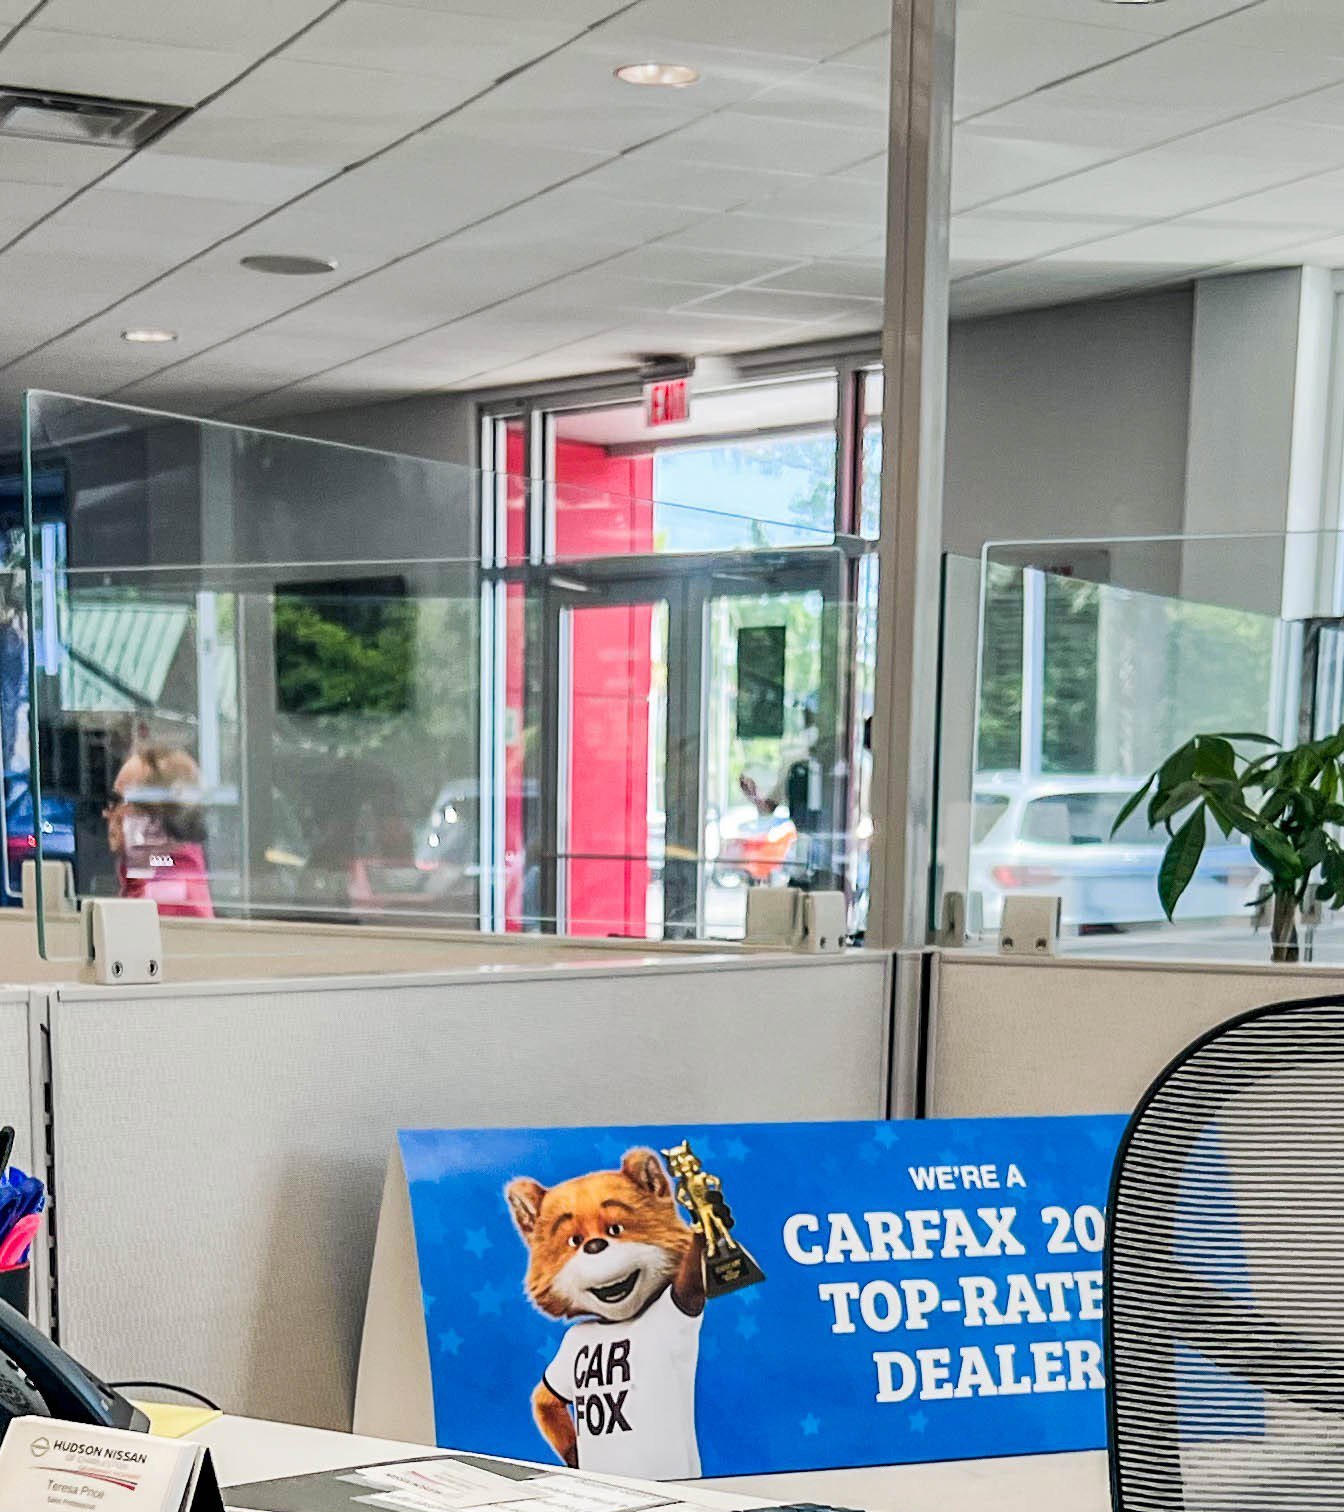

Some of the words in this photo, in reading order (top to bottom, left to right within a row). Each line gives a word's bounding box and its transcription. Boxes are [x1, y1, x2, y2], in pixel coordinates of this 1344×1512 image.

[908, 1165, 1001, 1191] WE'RE
[1006, 1163, 1027, 1188] A
[783, 1206, 1026, 1265] CARFAX
[818, 1270, 1104, 1334] TOP-RATE
[574, 1339, 631, 1389] CAR
[872, 1340, 1107, 1403] DEALER
[575, 1390, 633, 1436] FOX
[53, 1440, 102, 1458] HUDSON
[105, 1448, 148, 1465] NISSAN
[47, 1479, 79, 1495] Teresa
